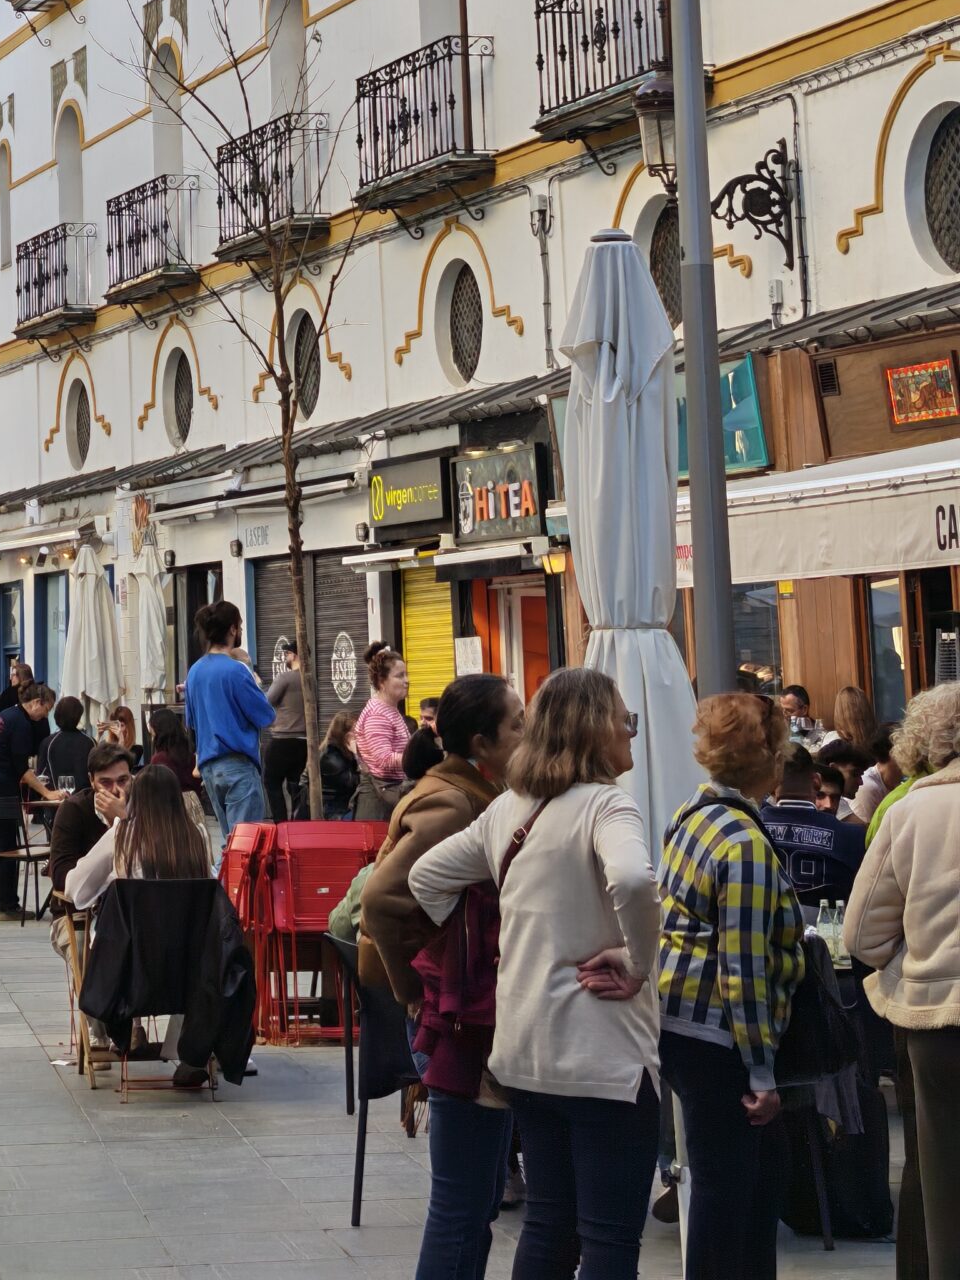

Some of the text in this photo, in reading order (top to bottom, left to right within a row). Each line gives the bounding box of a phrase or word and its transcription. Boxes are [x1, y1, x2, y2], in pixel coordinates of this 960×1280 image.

[936, 504, 960, 551] CA
[764, 824, 832, 847] EW YORK
